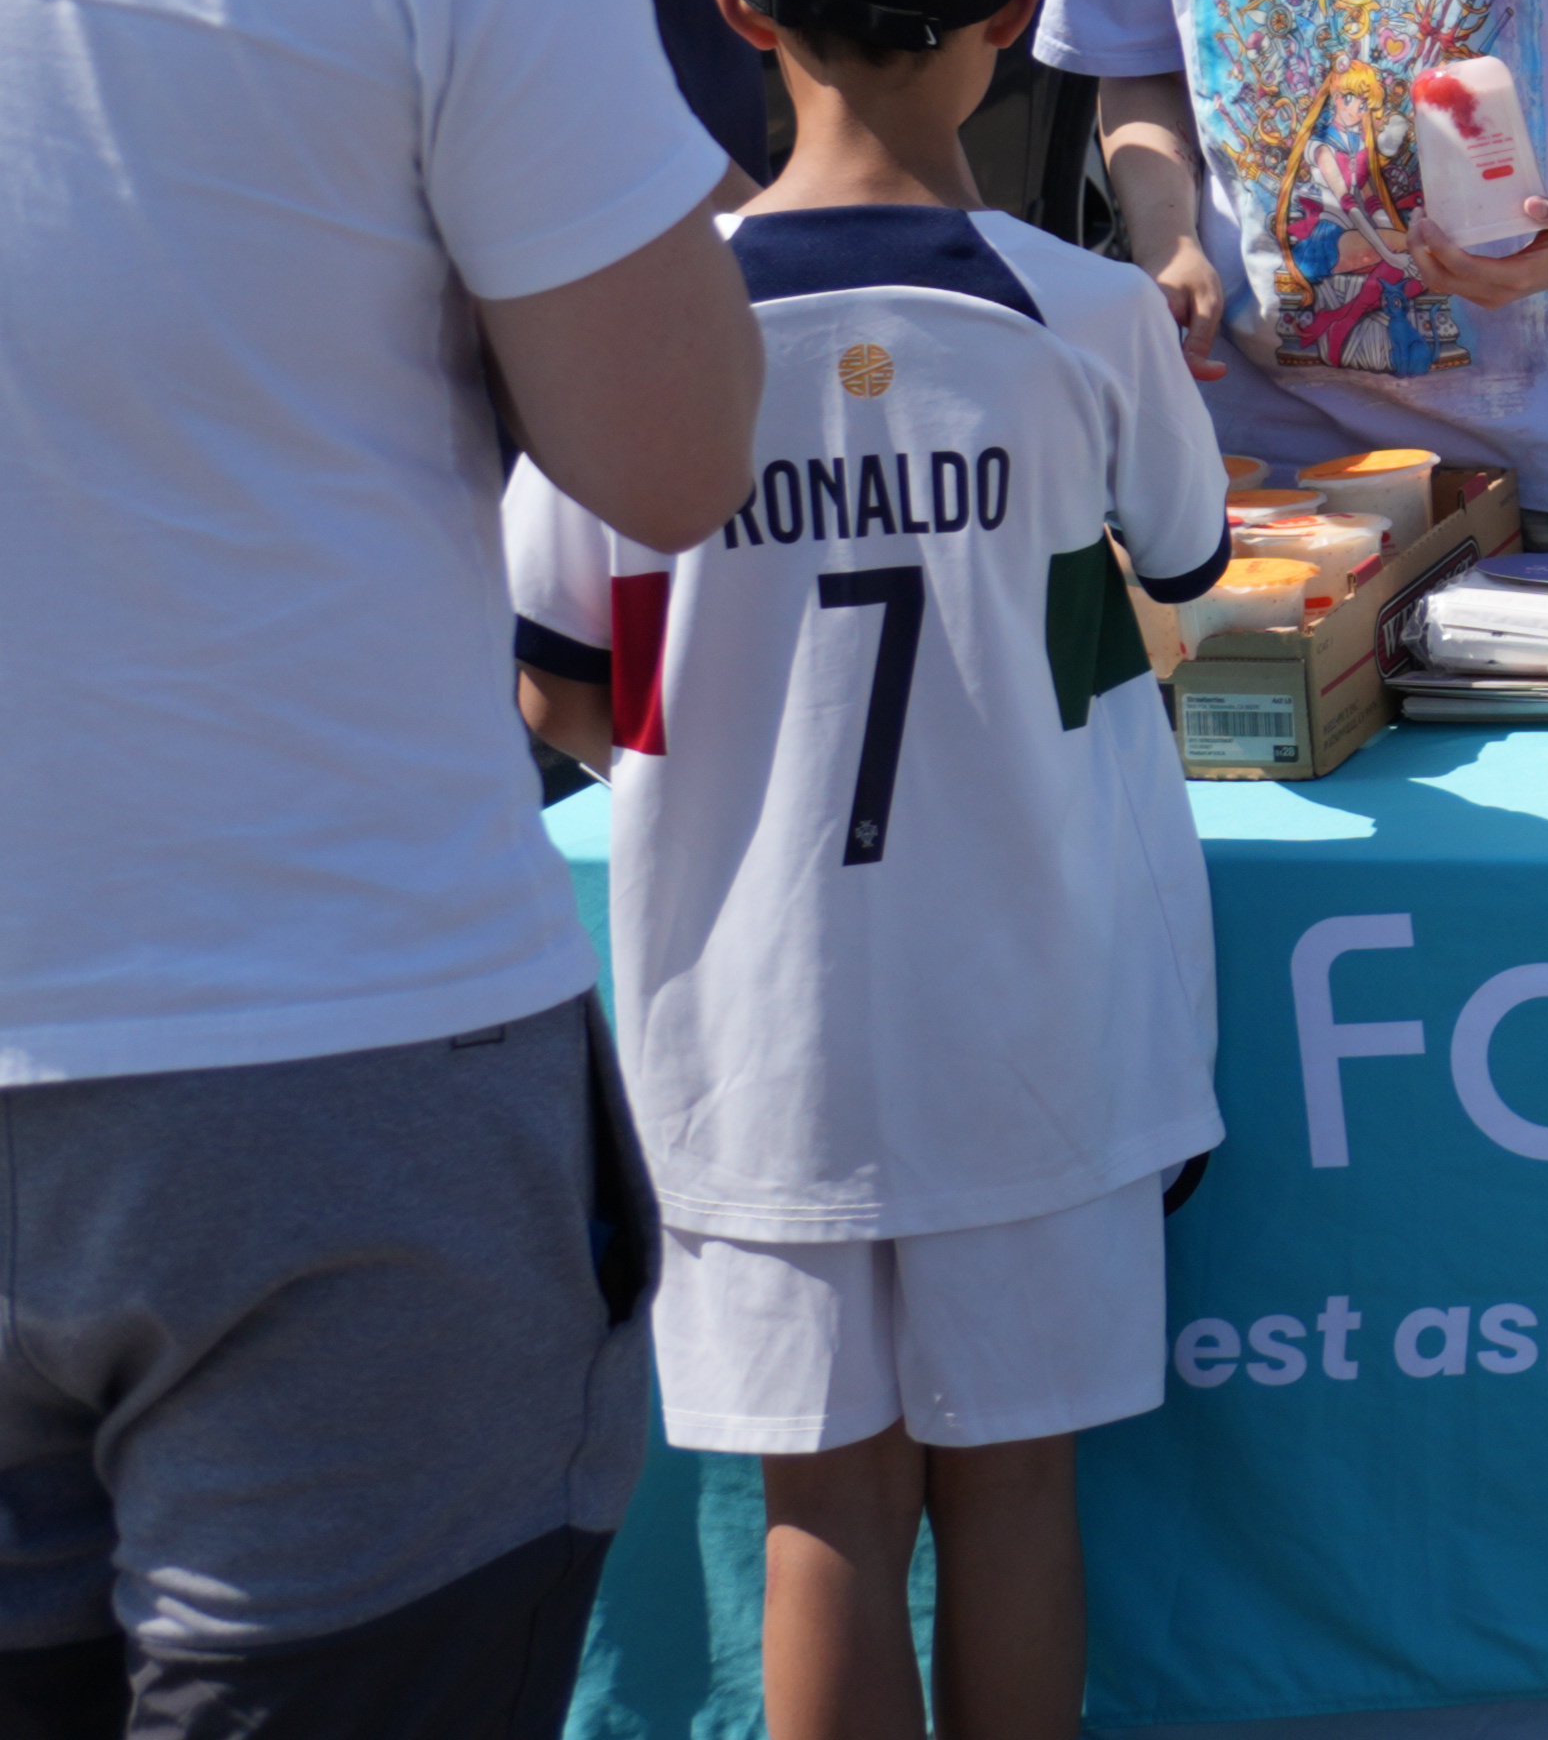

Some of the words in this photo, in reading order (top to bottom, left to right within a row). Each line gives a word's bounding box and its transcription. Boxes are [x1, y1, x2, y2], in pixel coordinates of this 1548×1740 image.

[723, 443, 1012, 551] RONALDO
[817, 563, 926, 868] 7
[1164, 1292, 1362, 1389] est
